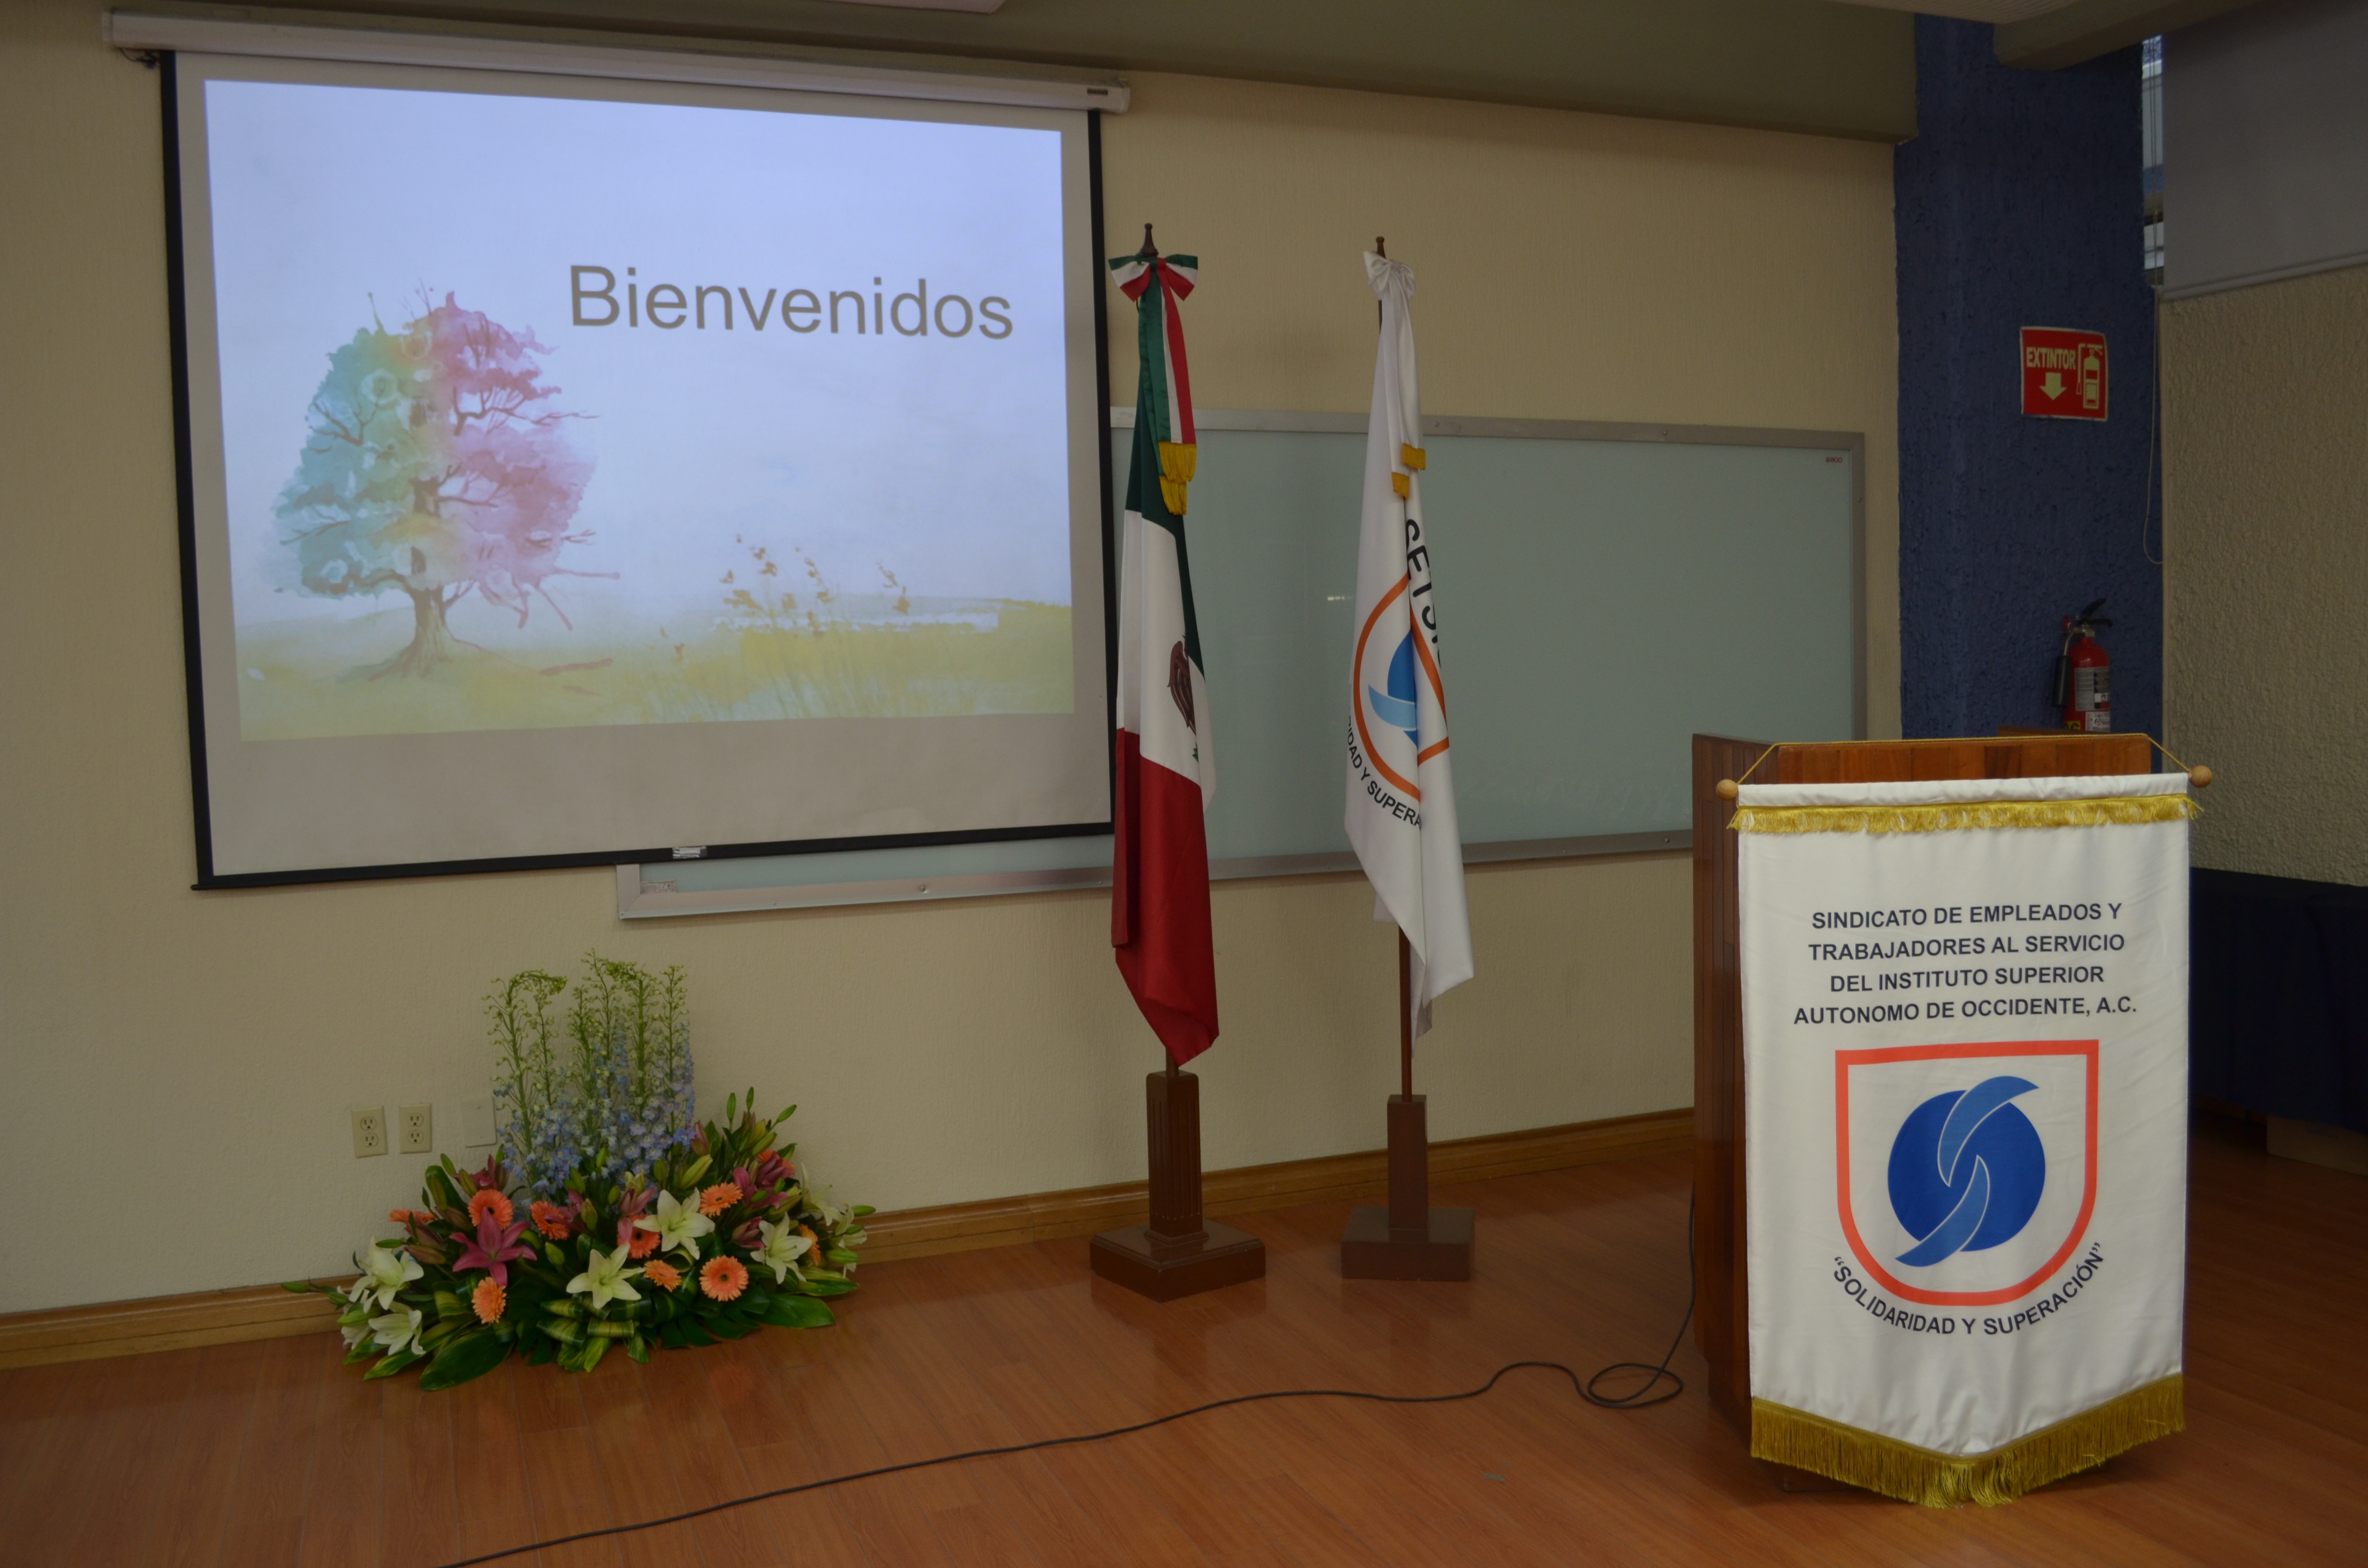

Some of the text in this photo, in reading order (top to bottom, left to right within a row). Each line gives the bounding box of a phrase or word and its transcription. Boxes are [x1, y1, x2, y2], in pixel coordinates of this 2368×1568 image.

[571, 265, 1013, 340] Bienvenidos
[2026, 346, 2076, 370] EXTINTOR
[1361, 766, 1370, 781] Y
[1813, 904, 2121, 929] SINDICATO DE EMPLEADOS Y
[1809, 934, 2124, 960] TRABAJADORES AL SERVICIO
[1831, 966, 2104, 992] DEL INSTITUTO SUPERIOR
[1795, 996, 2136, 1024] AUTONOMO DE OCCIDENTE, A.C.
[1962, 1319, 1975, 1334] Y
